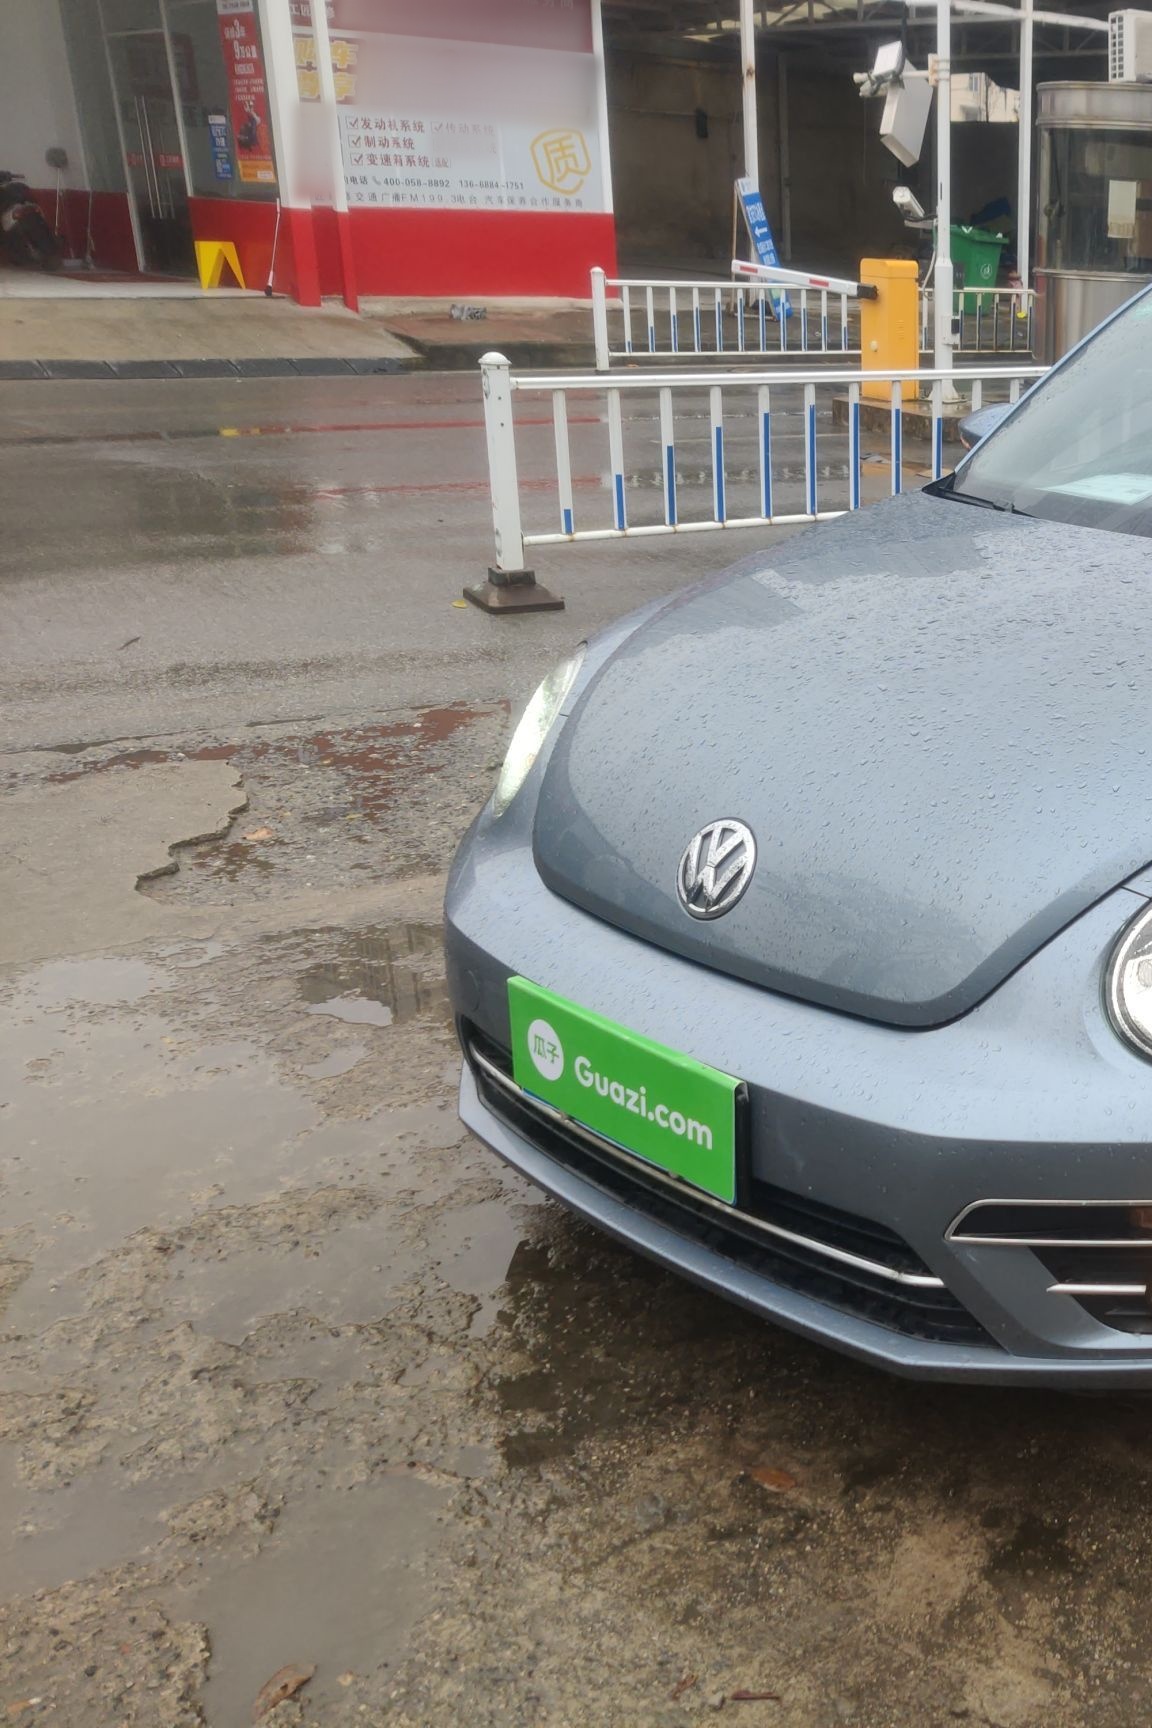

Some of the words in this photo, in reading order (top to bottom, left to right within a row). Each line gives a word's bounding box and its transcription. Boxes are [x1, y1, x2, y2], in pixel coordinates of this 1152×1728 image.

[360, 116, 425, 133] 发动机系统
[363, 135, 415, 150] 制动系统
[366, 153, 430, 168] 变速箱系统
[538, 131, 588, 188] 质
[533, 1033, 561, 1065] 瓜子
[573, 1055, 714, 1151] Guazi.com
